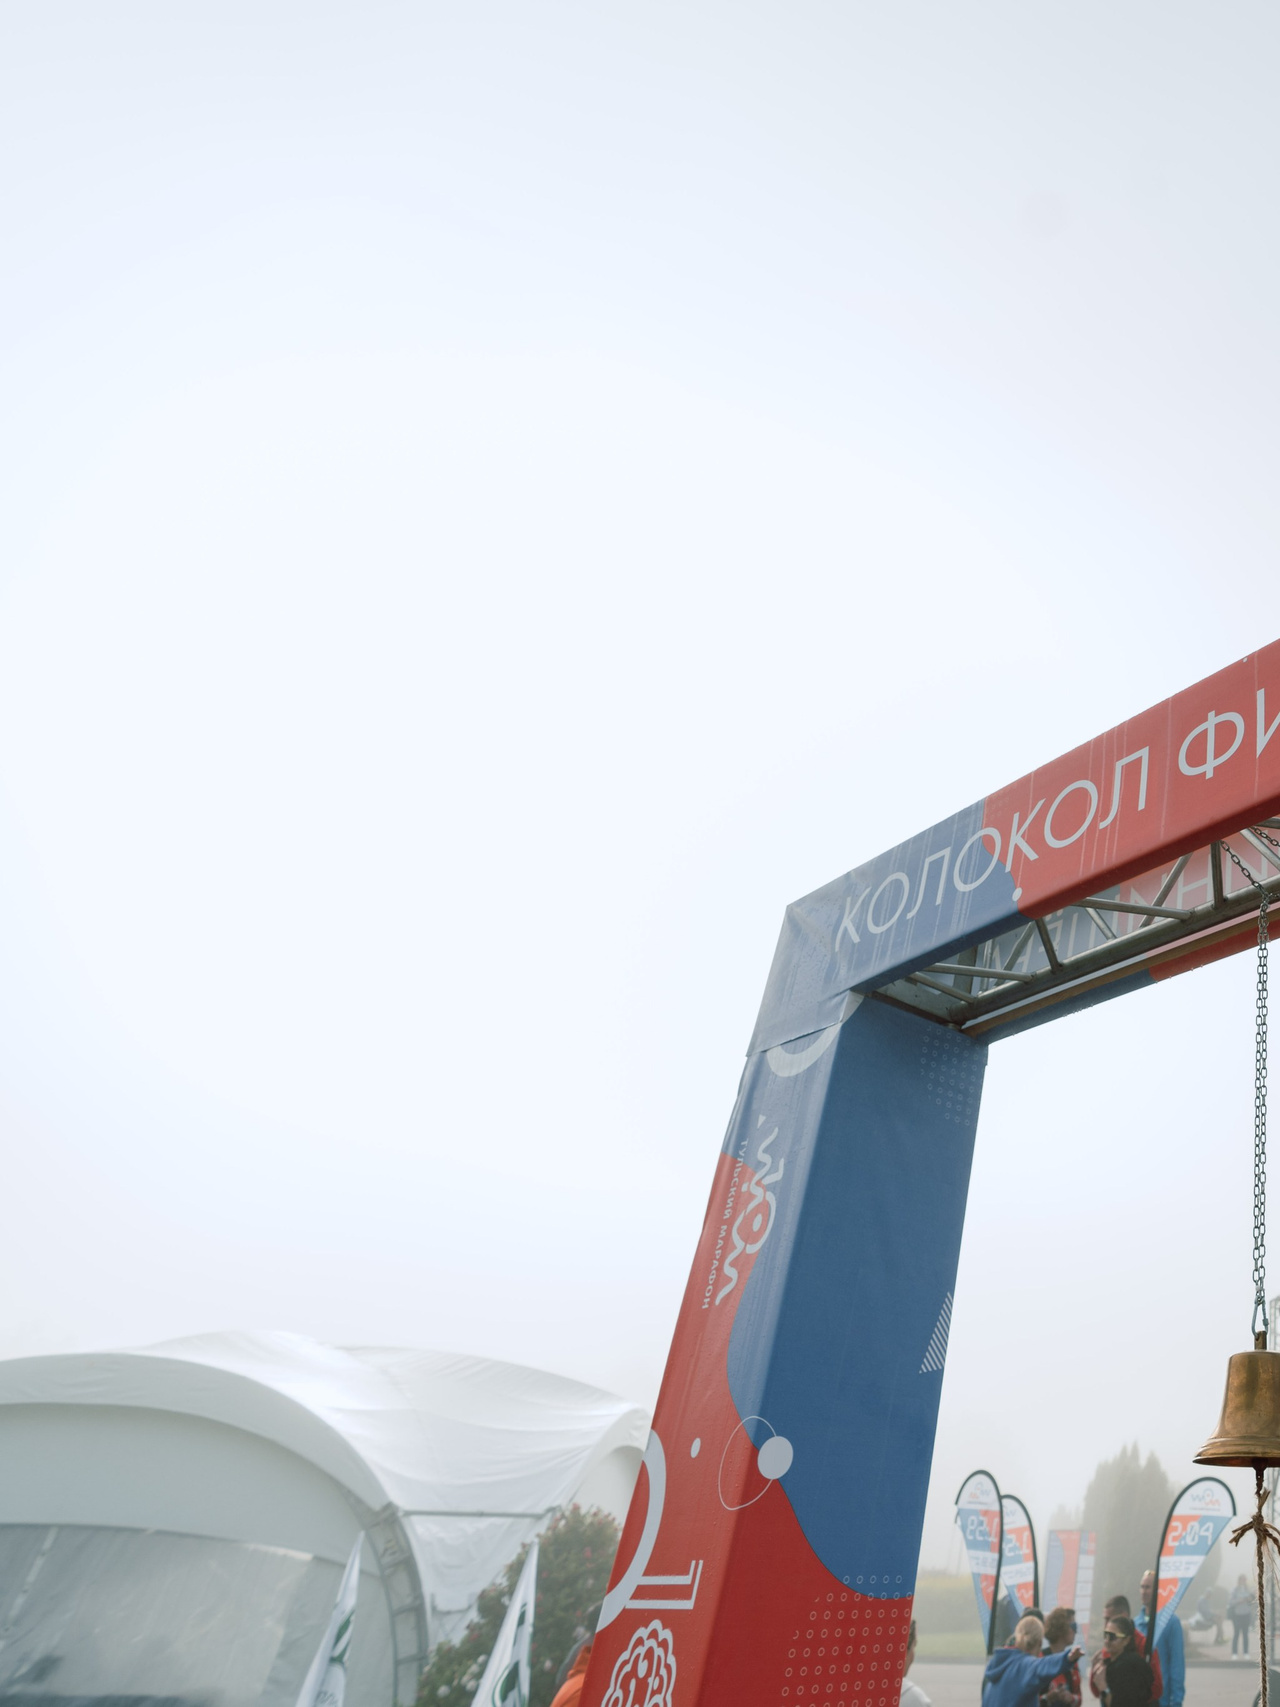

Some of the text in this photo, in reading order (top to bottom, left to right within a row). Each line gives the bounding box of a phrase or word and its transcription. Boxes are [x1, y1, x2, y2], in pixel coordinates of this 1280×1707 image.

[833, 745, 1151, 952] КОЛОКОЛ
[702, 1137, 750, 1310] ТУЛЬСКИЙ МАРАФОН
[1167, 1520, 1215, 1547] 2:04
